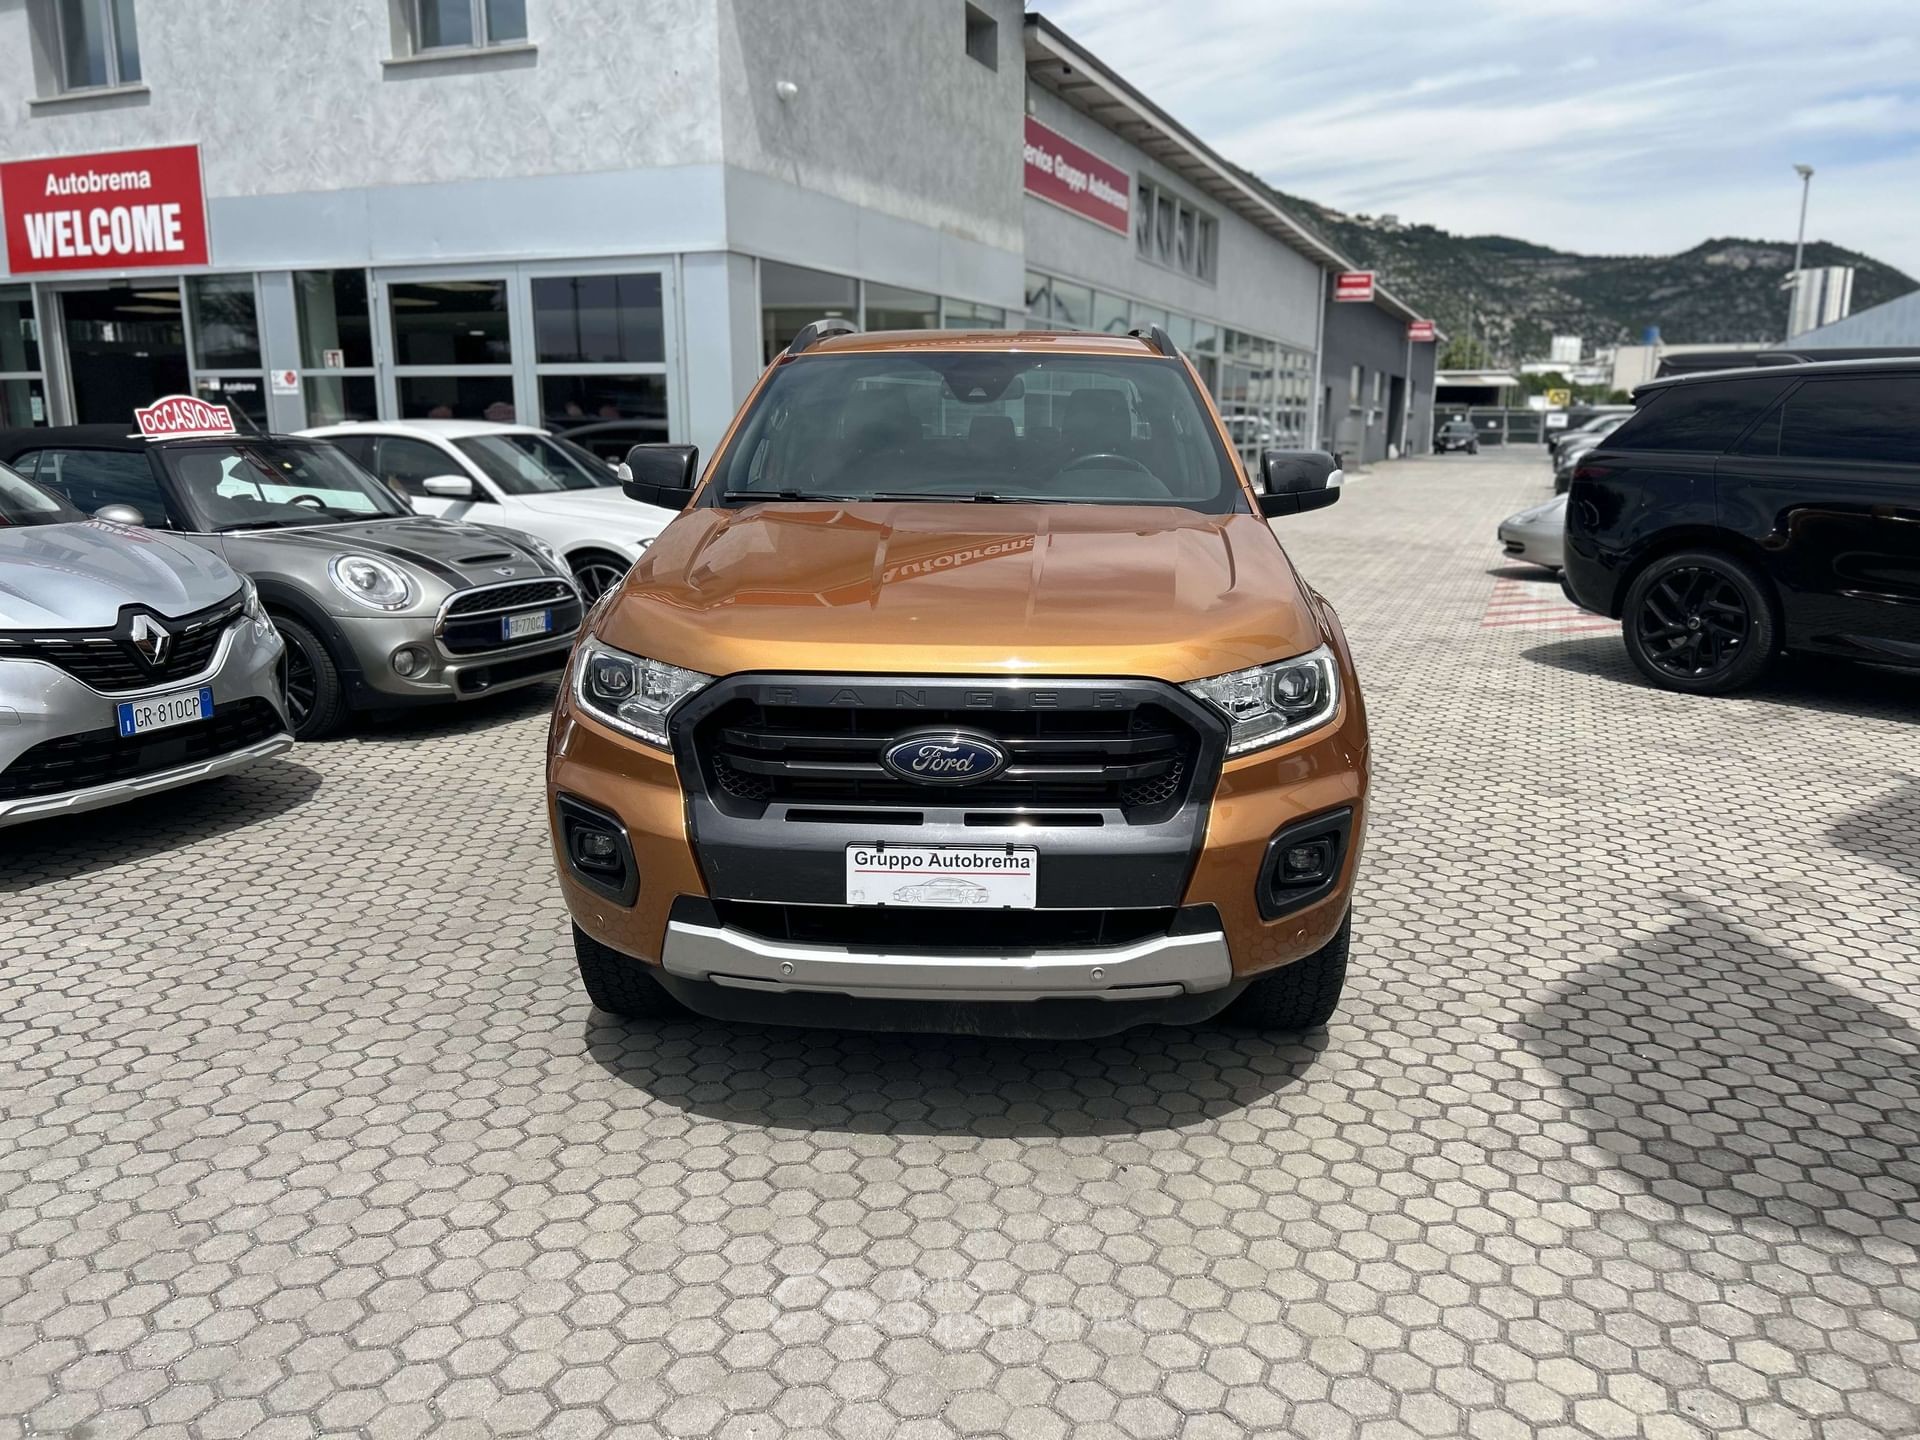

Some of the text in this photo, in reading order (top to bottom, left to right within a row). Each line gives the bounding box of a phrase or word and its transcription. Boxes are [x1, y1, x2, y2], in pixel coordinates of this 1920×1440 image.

[44, 169, 152, 197] Autobrema
[24, 202, 185, 260] WELCOME
[143, 401, 231, 433] OCCASIONE
[768, 686, 1125, 708] RANGER
[911, 744, 975, 773] Ford
[854, 851, 1031, 870] Gruppo Autobrema
